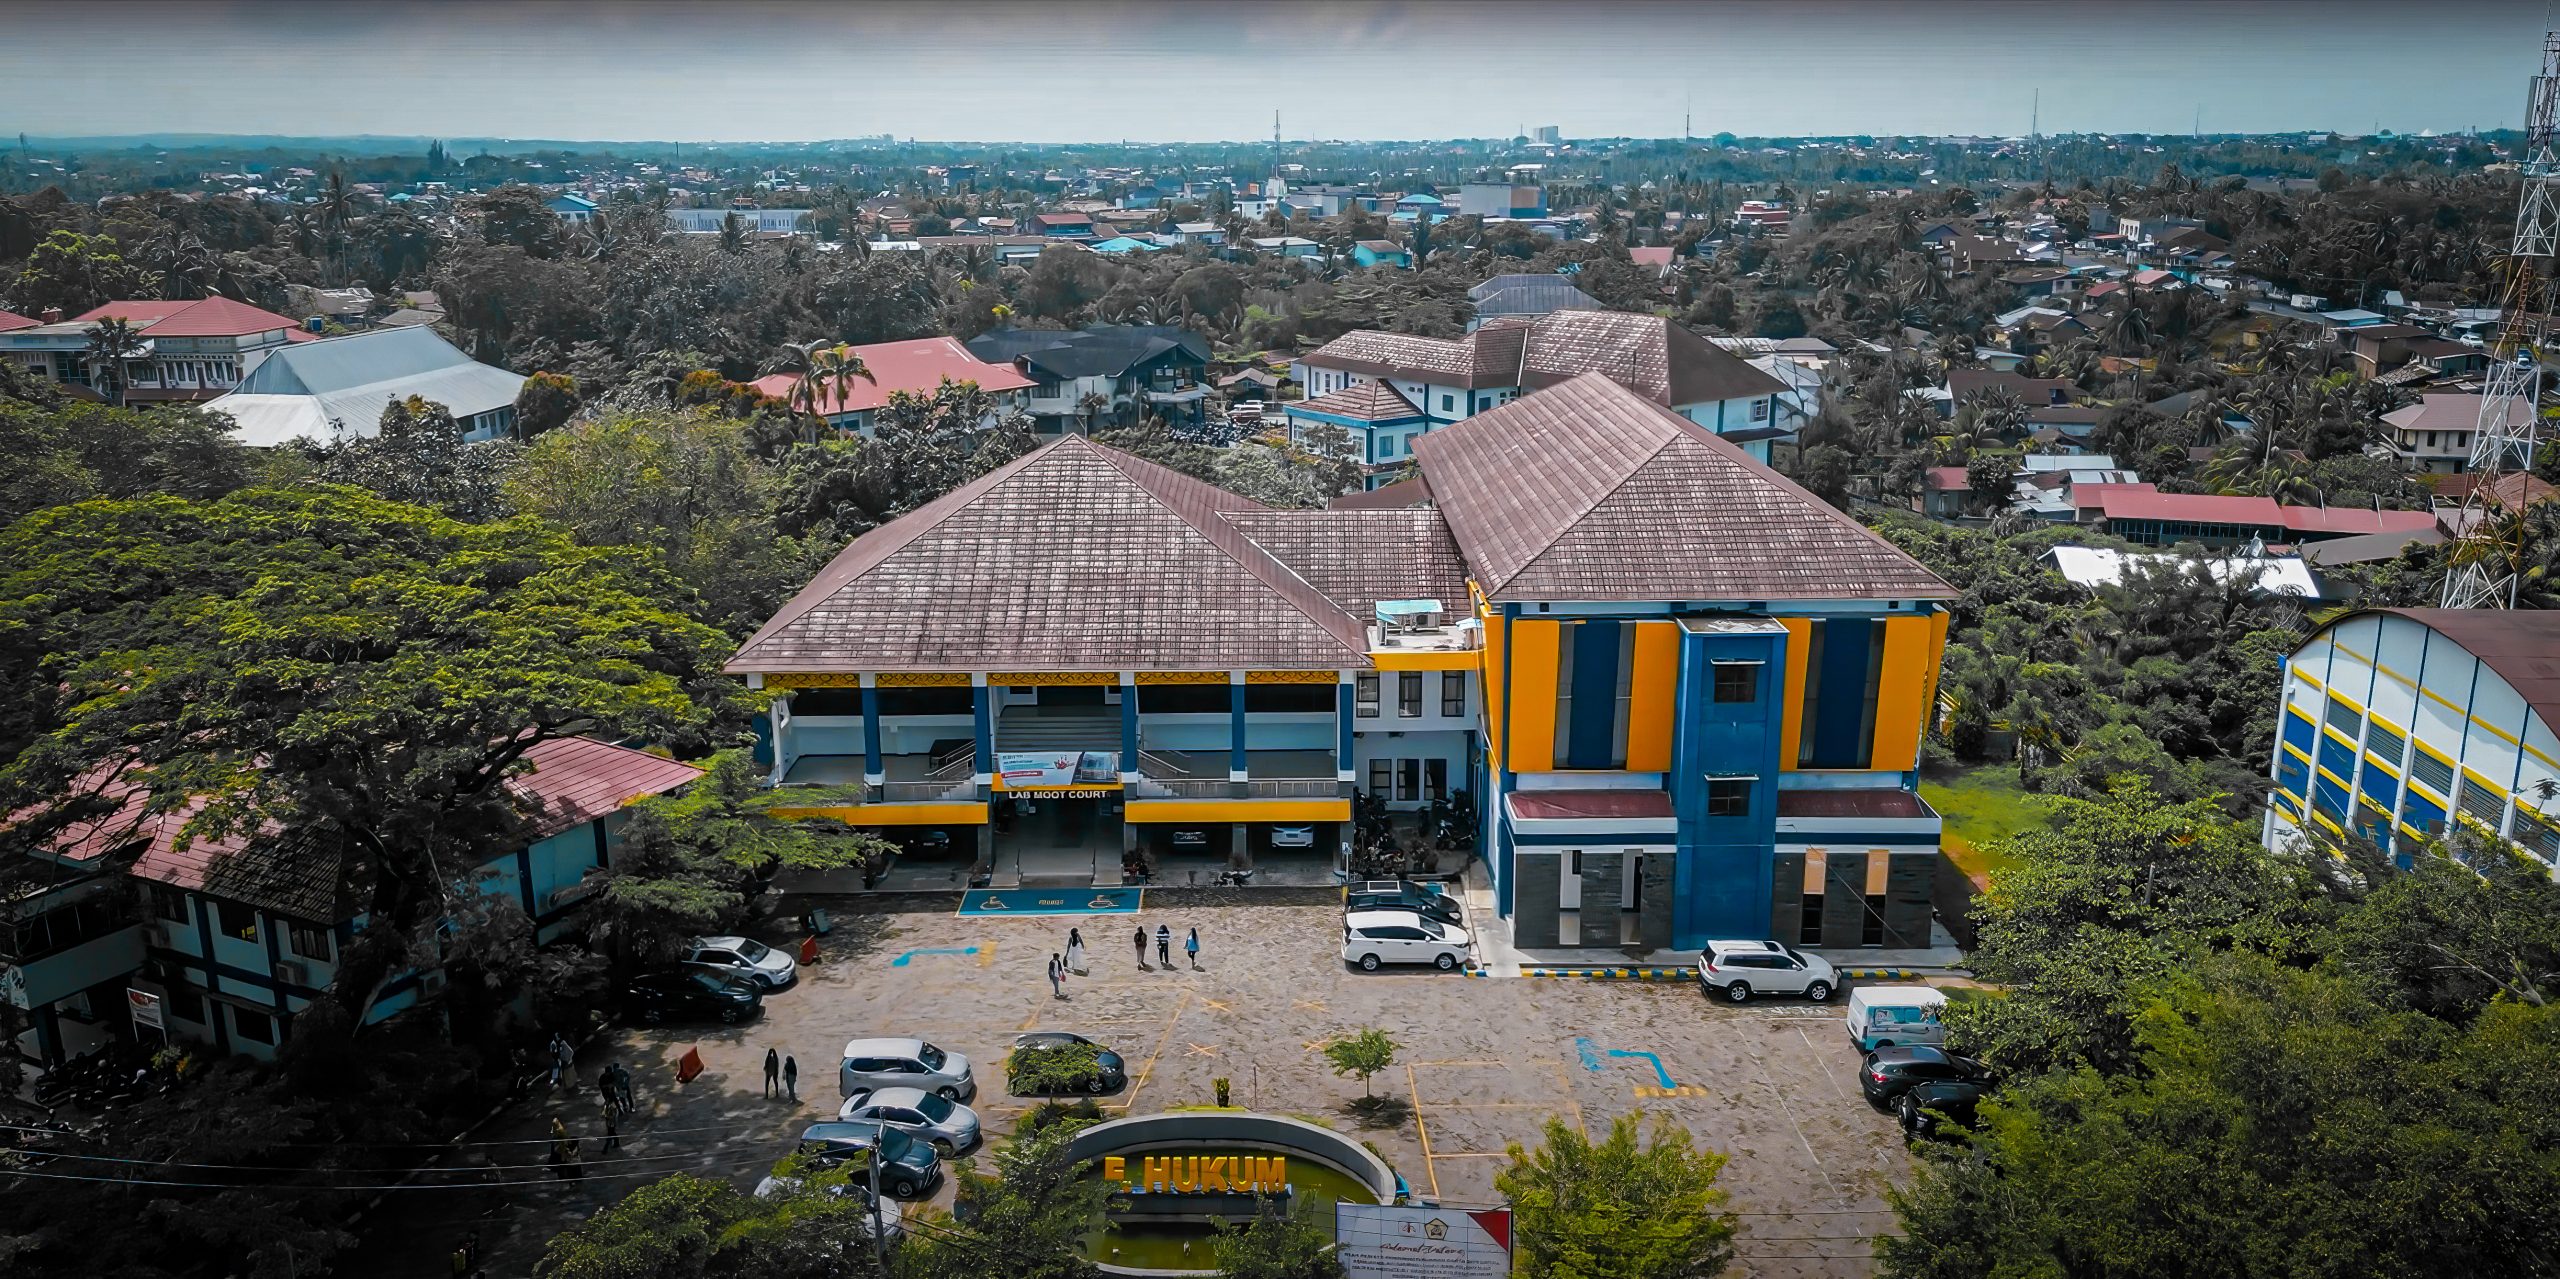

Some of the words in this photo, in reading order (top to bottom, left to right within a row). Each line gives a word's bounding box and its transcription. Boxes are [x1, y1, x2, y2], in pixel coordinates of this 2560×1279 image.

[1008, 790, 1031, 799] LAB
[1034, 790, 1066, 799] MOOT
[1069, 790, 1108, 799] COURT
[1144, 1156, 1286, 1194] HUKUM
